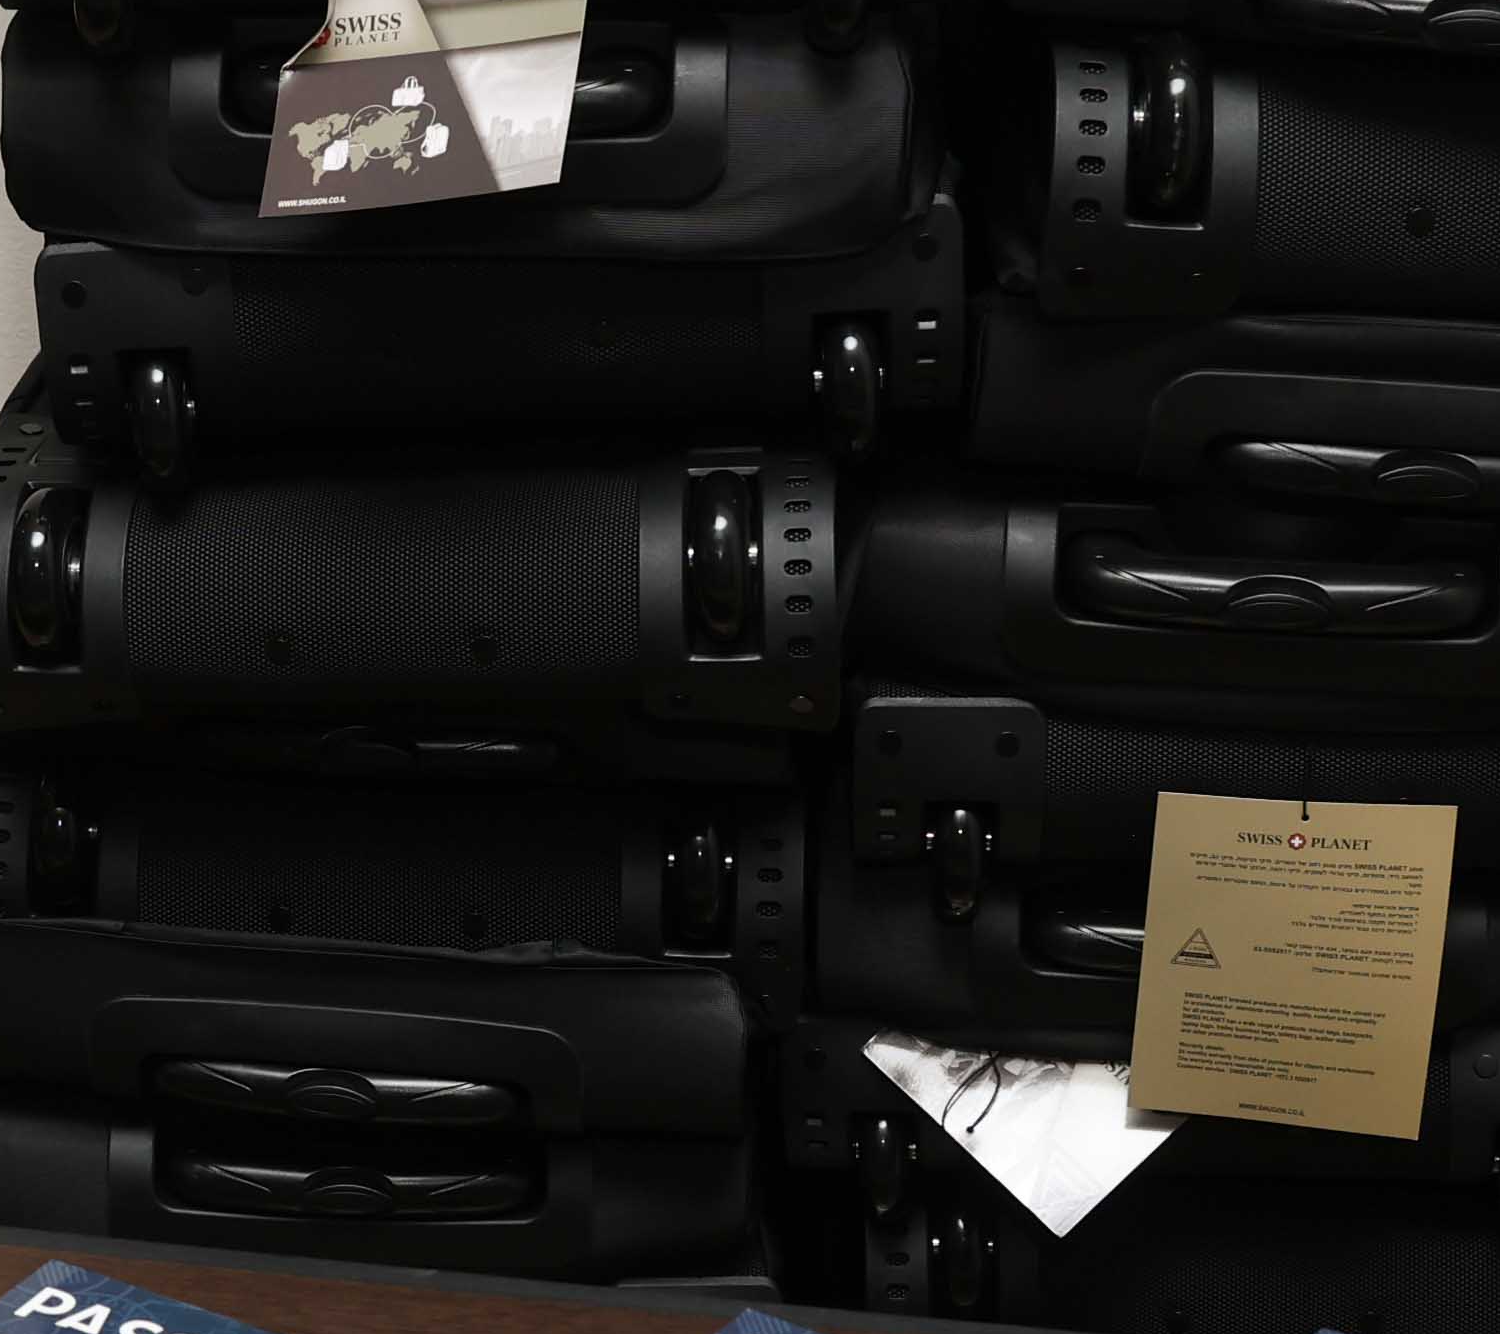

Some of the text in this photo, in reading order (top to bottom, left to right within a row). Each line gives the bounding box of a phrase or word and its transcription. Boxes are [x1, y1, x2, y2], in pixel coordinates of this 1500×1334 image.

[335, 13, 401, 35] SWISS
[334, 31, 401, 47] PLANET
[1237, 831, 1372, 851] SWISS PLANET
